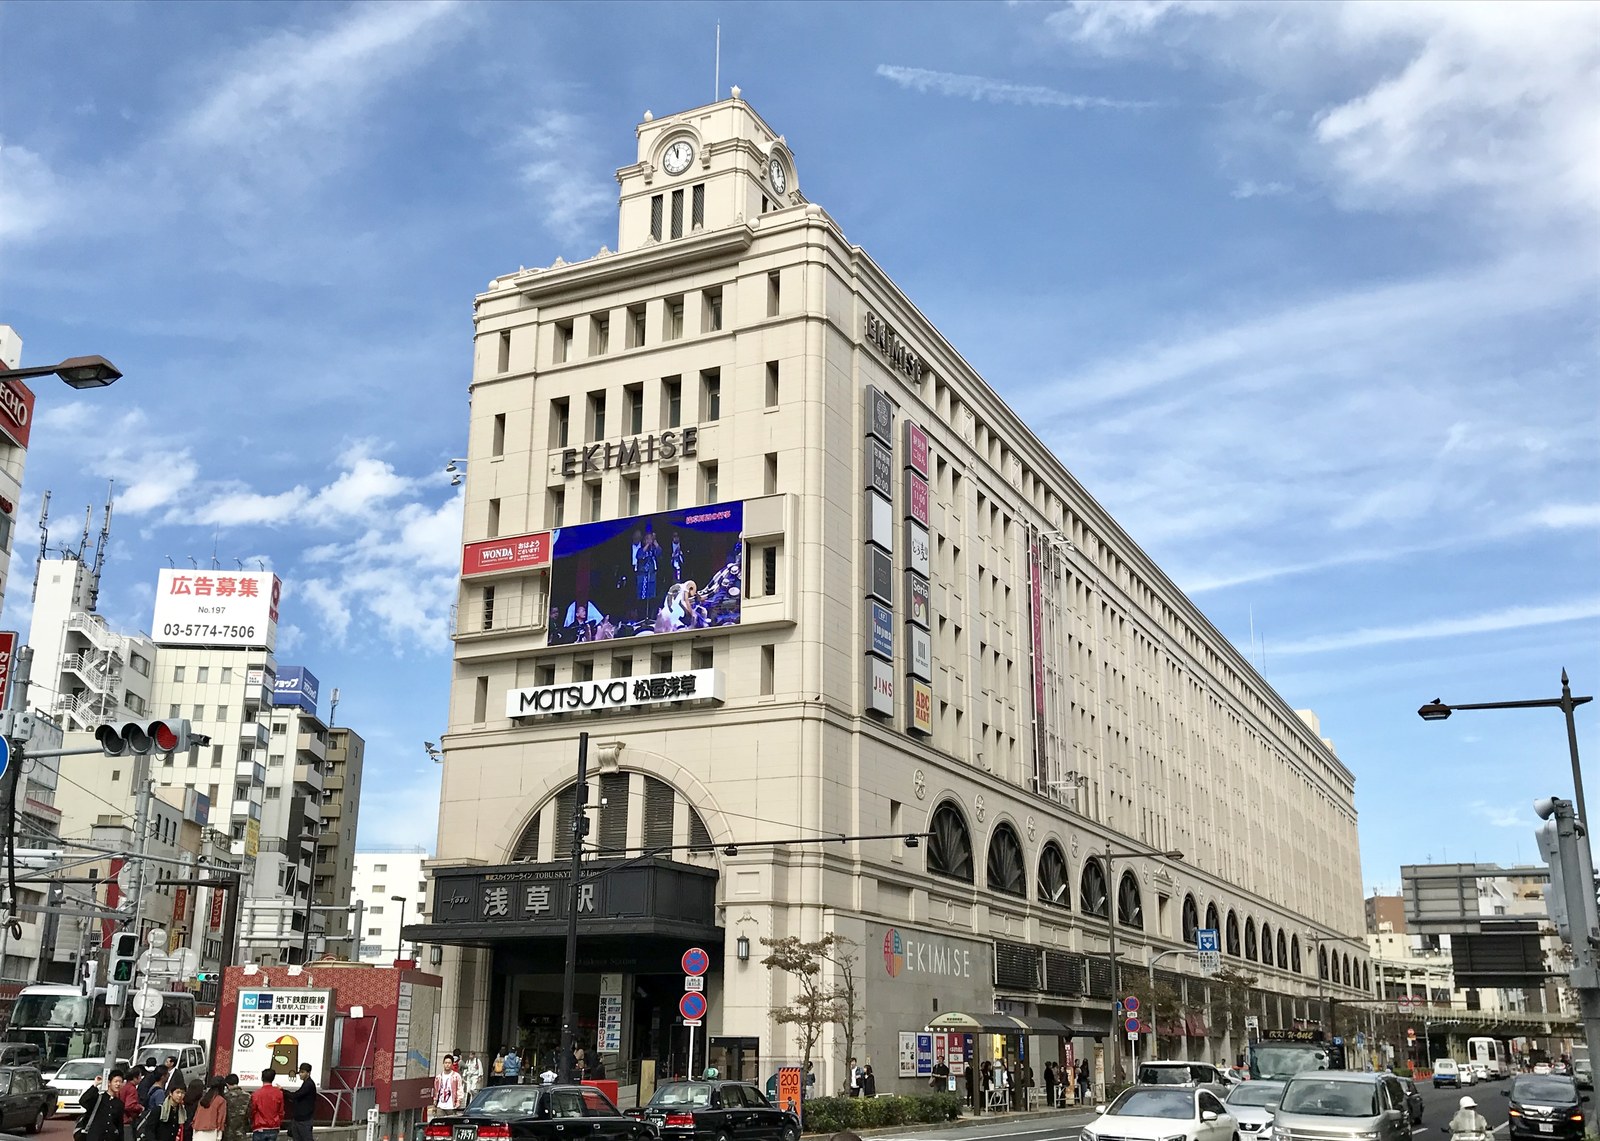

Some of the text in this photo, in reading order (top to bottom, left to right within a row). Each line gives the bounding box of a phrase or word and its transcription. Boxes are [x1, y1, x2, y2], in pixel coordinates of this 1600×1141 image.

[865, 311, 921, 384] EKIMISE
[562, 427, 697, 476] EKIMISE
[518, 540, 540, 549] おはよう
[482, 548, 513, 560] WONDA
[170, 576, 259, 598] 広告募集
[913, 579, 929, 599] Seria
[198, 606, 226, 614] No.197
[164, 623, 255, 638] 03-5774-7506
[632, 674, 696, 700] 松屋浅草
[916, 690, 930, 711] ABC
[916, 707, 930, 724] MART
[906, 941, 970, 978] EKIMISE
[276, 995, 325, 1004] 地下鉄銀座線
[781, 1074, 798, 1085] 200
